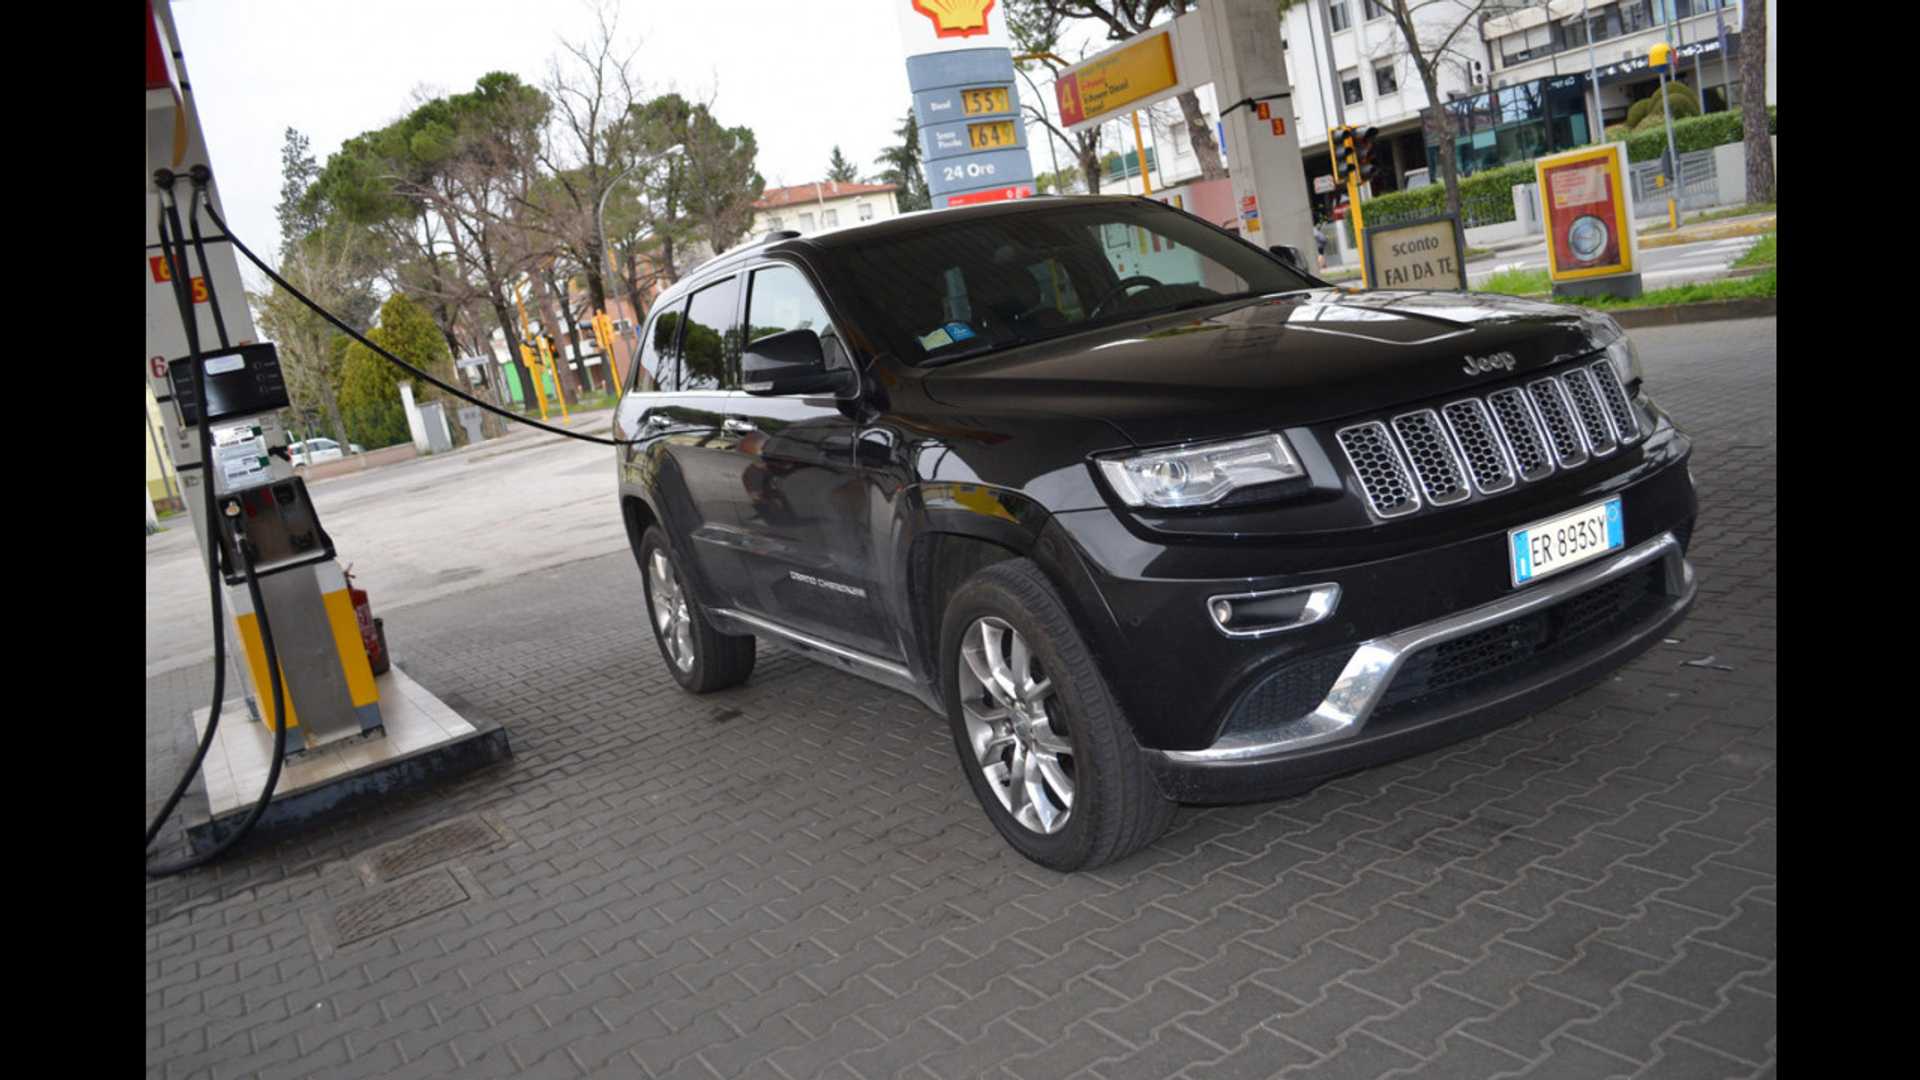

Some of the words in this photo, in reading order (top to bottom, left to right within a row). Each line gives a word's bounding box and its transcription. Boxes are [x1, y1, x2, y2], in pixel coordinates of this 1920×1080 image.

[1062, 80, 1076, 117] 4
[943, 164, 964, 181] 24
[967, 162, 995, 177] Ore
[1392, 235, 1439, 257] sconto
[1384, 265, 1410, 287] FAI
[1412, 260, 1435, 281] DA
[1437, 256, 1456, 275] TE
[192, 276, 209, 302] 5
[150, 355, 168, 379] 6
[1463, 350, 1517, 377] Jeep
[1530, 532, 1552, 568] ER
[1556, 514, 1607, 557] 893SY
